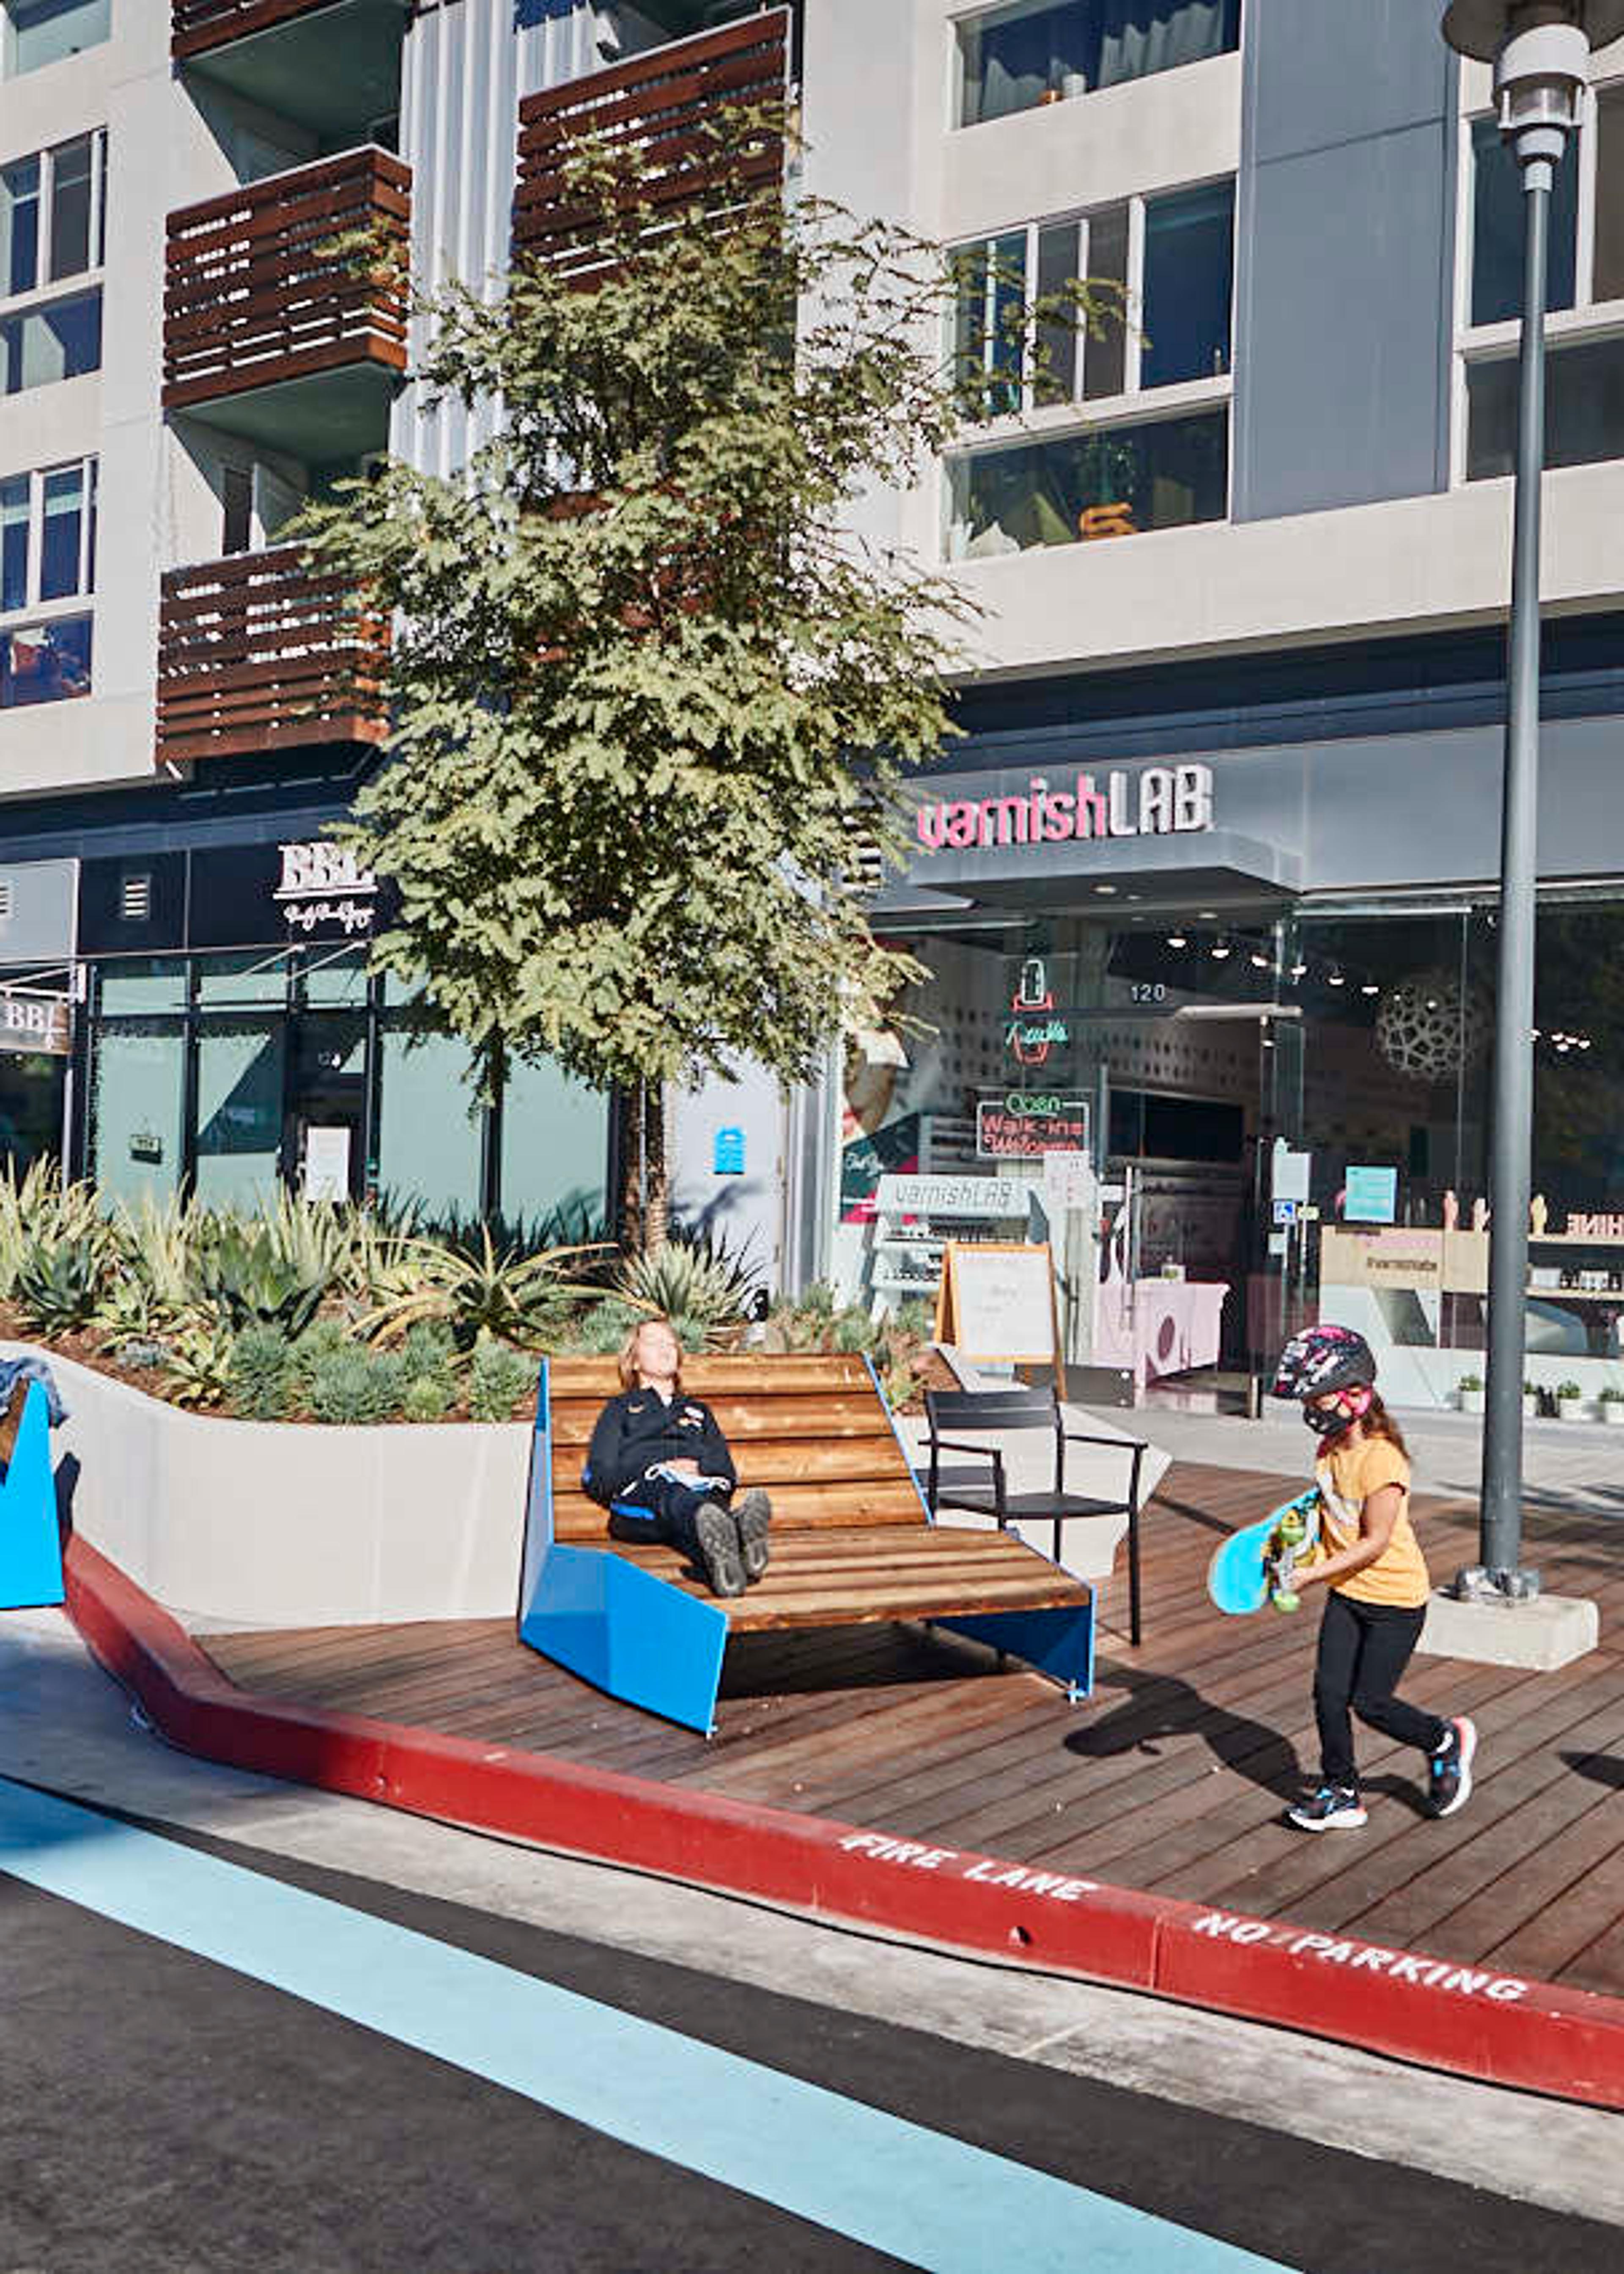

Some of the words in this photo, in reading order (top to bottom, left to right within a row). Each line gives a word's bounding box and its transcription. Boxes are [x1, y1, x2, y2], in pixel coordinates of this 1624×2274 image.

[1131, 983, 1165, 1001] 120
[837, 1833, 959, 1869] FIRE
[962, 1861, 1101, 1900] LANE
[1192, 1912, 1270, 1944] NO
[1288, 1933, 1528, 2001] PARKING
